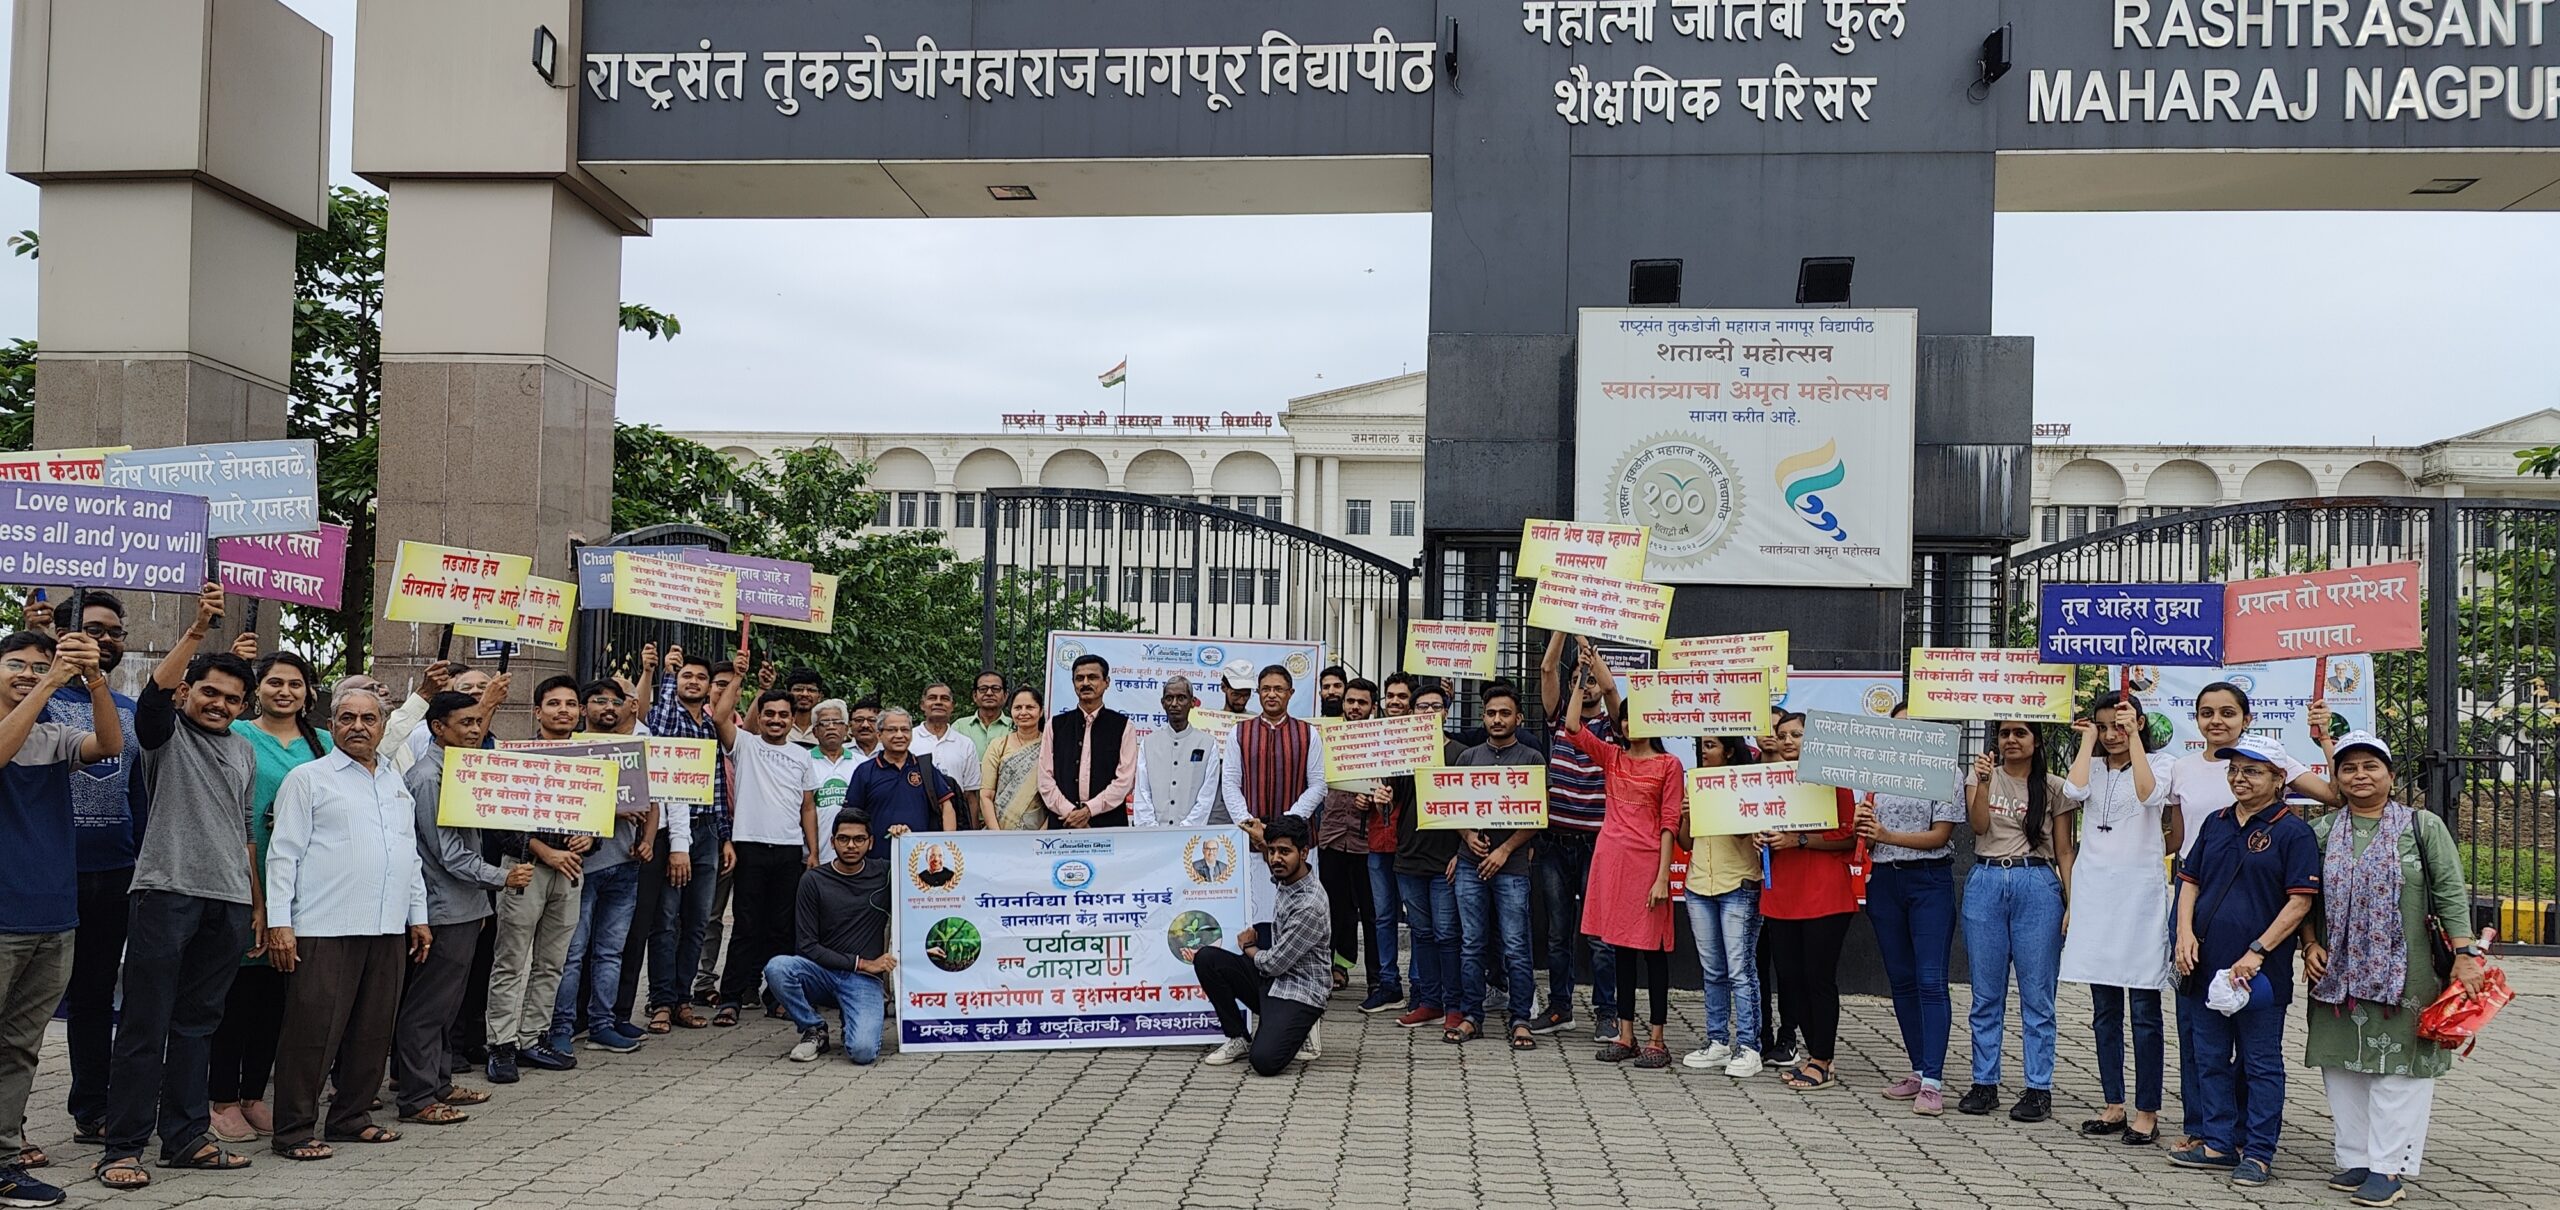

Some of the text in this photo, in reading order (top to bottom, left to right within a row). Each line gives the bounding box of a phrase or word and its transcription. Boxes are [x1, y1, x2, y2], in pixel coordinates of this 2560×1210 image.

[1522, 0, 1656, 46] महात्मा
[2113, 0, 2552, 48] RASHTRASANT
[587, 39, 747, 110] राष्ट्रसंत
[1105, 46, 1252, 111] नागपूर
[1258, 27, 1436, 94] विद्यापीठ
[1554, 63, 1877, 126] शैक्षणिक परिसर
[2028, 67, 2318, 123] MAHARAJ
[1619, 316, 1874, 338] राष्ट्रसंत तुकडोजी महाराज नागपूर विद्यापीठ
[1657, 338, 1833, 363] शताब्दी महोत्सव
[1739, 367, 1749, 378] व
[1601, 375, 1890, 406] स्वातंत्र्याचा अमृत महोत्सव
[1002, 410, 1273, 431] राष्ट्रसंत तुकडोजी महाराज नागपूर विद्यापीठ
[1689, 407, 1801, 424] साजरा करीत आहे.
[1352, 434, 1399, 443] जमनालाल
[110, 454, 217, 488] दोष पाहणारे
[1656, 445, 1696, 456] महाराज
[1698, 451, 1722, 478] नागपूर
[15, 488, 172, 521] Love work and
[250, 488, 313, 524] राजहंस
[1642, 481, 1705, 519] १००
[43, 523, 201, 554] all and you will
[287, 534, 323, 558] तसा
[1564, 523, 1641, 549] श्रेष्ठ यज्ञ म्हणजे
[1555, 552, 1607, 570] नामस्मरण
[1759, 542, 1880, 558] स्वातंत्र्याचा अमृत महोत्सव
[22, 553, 185, 587] blessed by god
[442, 551, 500, 579] तडजोड हेच
[1551, 570, 1578, 582] सज्जन
[271, 569, 324, 601] आकार
[762, 568, 781, 585] आहे
[401, 573, 495, 612] जीवनाचे श्रेष्ठ मूल्य
[745, 589, 755, 602] हा
[1539, 580, 1640, 606] जीवनाचे तर
[2235, 573, 2409, 618] प्रयत्न तो परमेश्वर
[2060, 591, 2203, 626] तूच आहेस तुझ्या
[548, 616, 564, 634] होय
[1574, 615, 1597, 627] माती
[2048, 628, 2215, 661] जीवनाचा शिल्पकार
[2277, 624, 2362, 652] जाणावा.
[1924, 648, 2001, 663] जगातील सर्व
[1115, 674, 1158, 691] तुकडोजी
[1630, 669, 1762, 691] सुंदर विचारांची जोपासना
[1913, 667, 2066, 686] लोकांसाठी सर्व शक्तीमान
[1671, 688, 1721, 707] हीच आहे
[1927, 688, 2047, 708] परमेश्वर एकच आहे
[1643, 708, 1752, 724] परमेश्वराची उपासना
[2262, 711, 2295, 723] नागपूर
[1814, 715, 1924, 744] परमेश्वर समोर
[675, 747, 701, 760] करता
[1803, 737, 1905, 765] शरीर जवळ आहे व
[2185, 741, 2205, 750] हाच
[462, 752, 571, 774] शुभ चिंतन करणे हेच
[456, 768, 565, 789] शुभ इच्छा करणे हीच
[1433, 771, 1464, 790] ज्ञान
[1470, 772, 1500, 790] हाच
[1506, 768, 1530, 790] देव
[1695, 768, 1762, 793] प्रयत्न हे रत्न
[1859, 766, 1871, 784] तो
[472, 786, 552, 805] शुभ हेच
[1424, 795, 1542, 818] अज्ञान हा सैतान
[476, 803, 580, 824] शुभ करणे हेच पूजन
[1739, 795, 1786, 819] श्रेष्ठ आहे
[975, 892, 1066, 908] जीवनविद्या
[1074, 892, 1124, 907] मिशन
[1131, 888, 1173, 909] मुंबई
[1001, 909, 1149, 929] ज्ञानसाधना केंद्र नागपूर
[997, 957, 1025, 972] हाच
[909, 980, 1161, 1015] भव्य वृक्षारोपण व वृक्षसंवर्धन
[976, 1015, 1031, 1037] कृती ही
